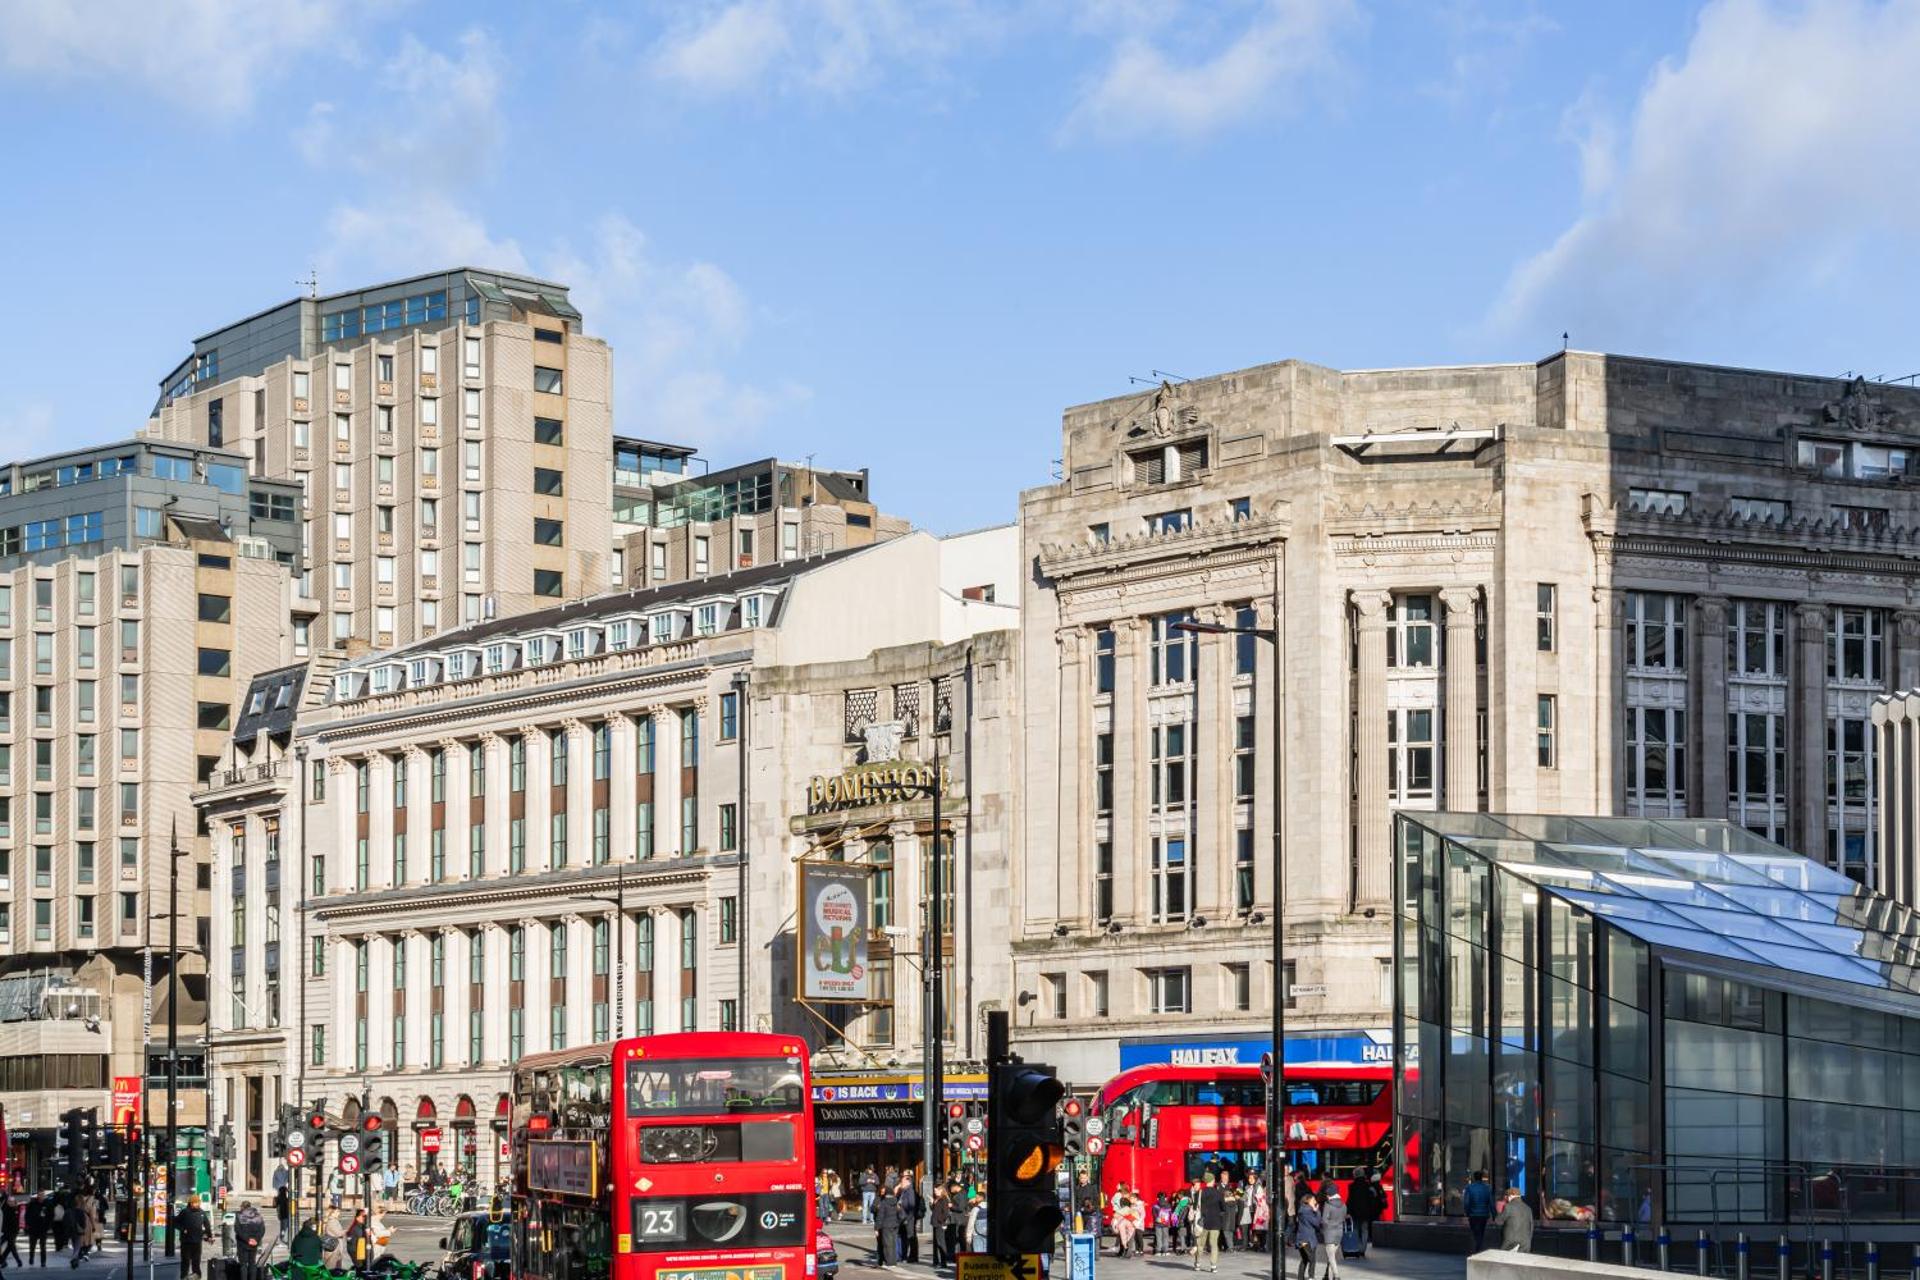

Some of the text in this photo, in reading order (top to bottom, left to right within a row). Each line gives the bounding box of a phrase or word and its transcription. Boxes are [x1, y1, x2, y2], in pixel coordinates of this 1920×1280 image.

[1171, 1048, 1238, 1065] HALIFAX
[838, 1087, 848, 1098] IS
[850, 1086, 878, 1098] BACK
[821, 1106, 916, 1120] DOMINION THEATRE
[644, 1210, 674, 1234] 23
[964, 1262, 989, 1270] Buses
